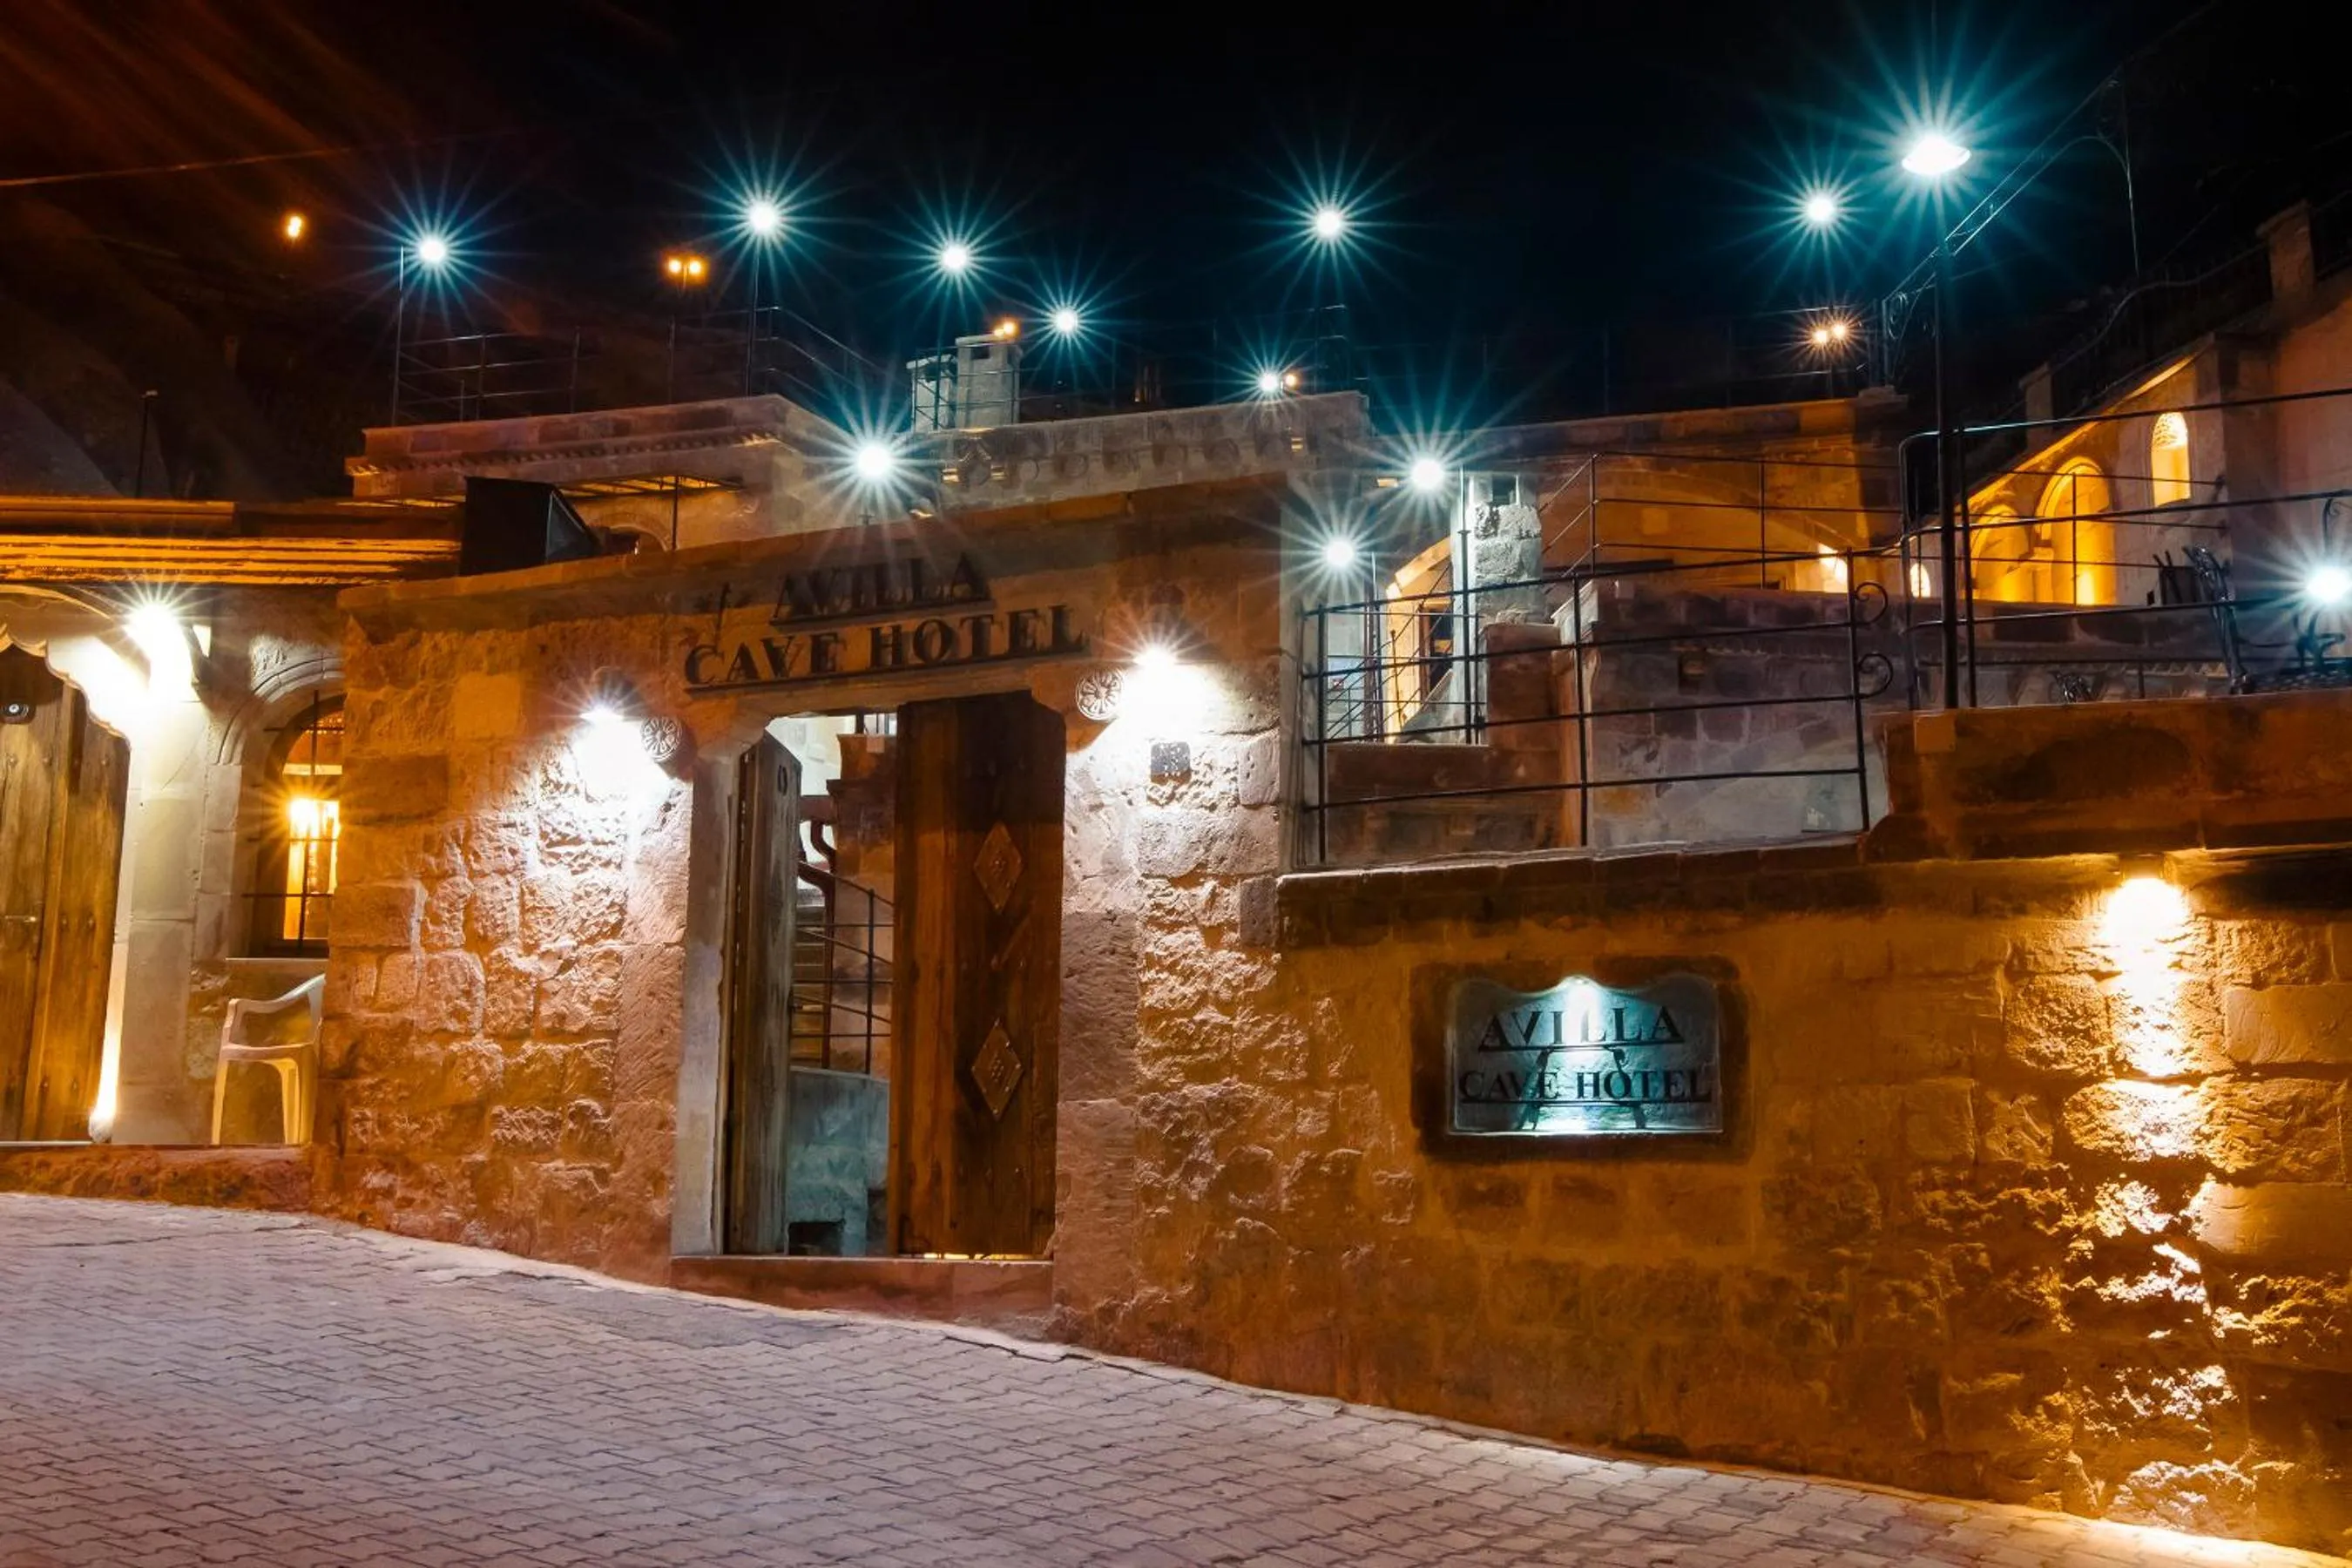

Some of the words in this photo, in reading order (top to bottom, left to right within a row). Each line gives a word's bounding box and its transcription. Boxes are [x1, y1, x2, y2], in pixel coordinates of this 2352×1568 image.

[772, 553, 991, 618] AVILLA
[684, 632, 848, 686] CAVE
[867, 604, 1087, 668] HOTEL
[1478, 1005, 1685, 1050] AVILLA
[1459, 1069, 1559, 1100] CAVE
[1576, 1069, 1712, 1102] HOTEL
